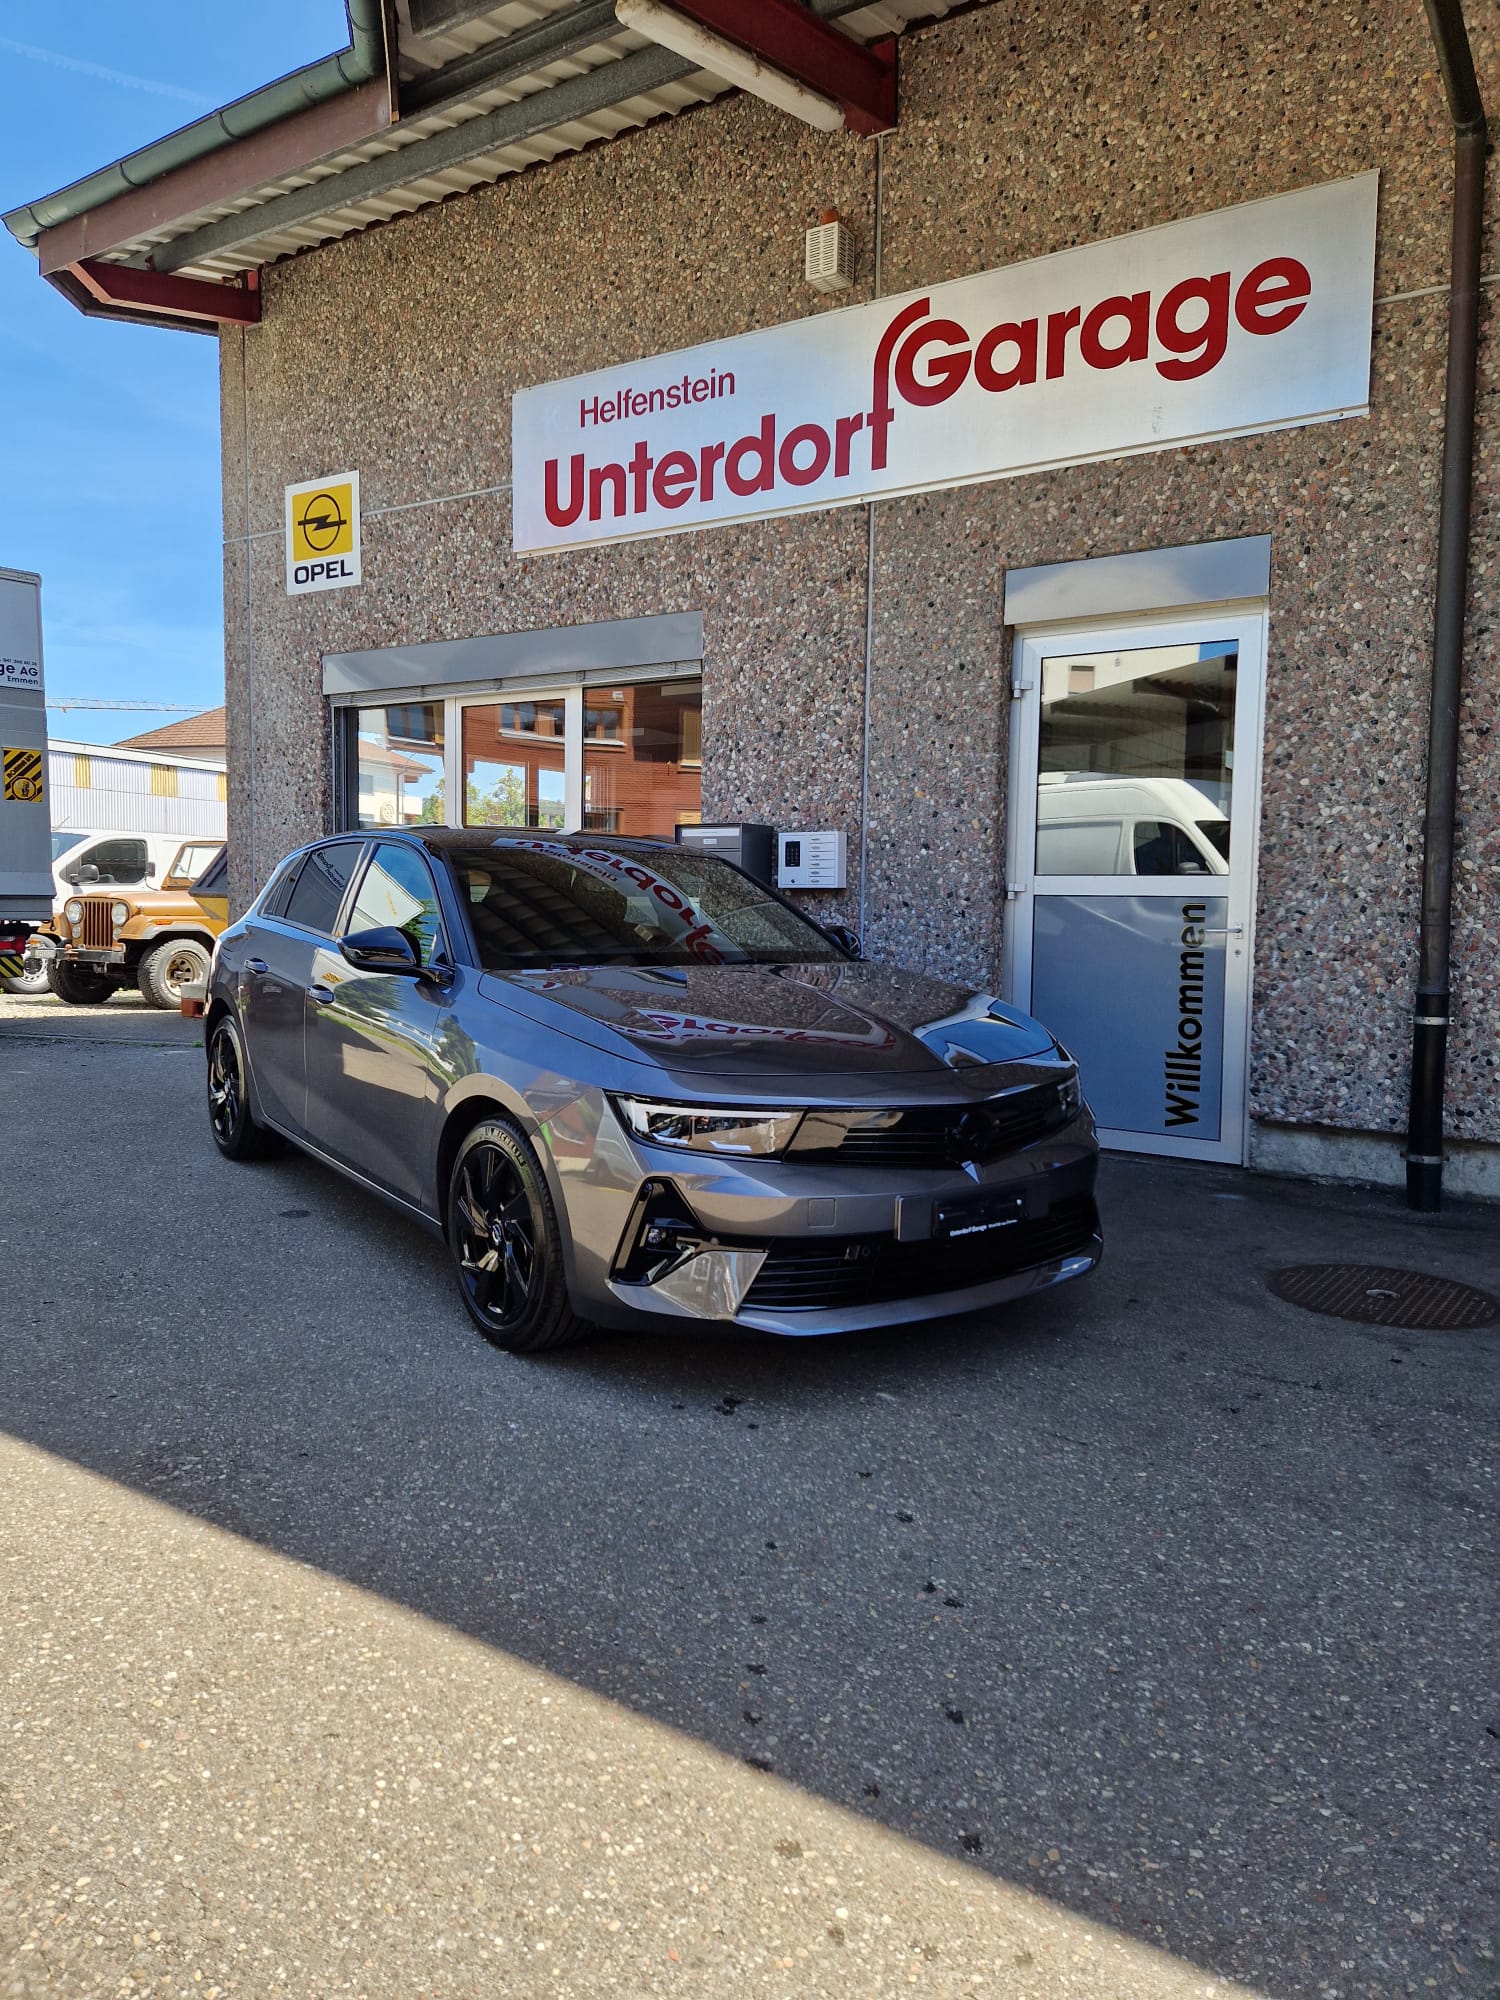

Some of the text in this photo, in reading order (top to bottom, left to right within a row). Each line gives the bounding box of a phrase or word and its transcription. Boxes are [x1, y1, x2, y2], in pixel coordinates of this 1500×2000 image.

[544, 256, 1311, 528] Unterdorf Garage
[579, 367, 736, 429] Helfenstein
[294, 559, 353, 585] OPEL
[7, 675, 39, 685] Emmen
[20, 666, 38, 677] AG
[1164, 902, 1207, 1127] Willkommen
[493, 1128, 527, 1166] MICHELIN
